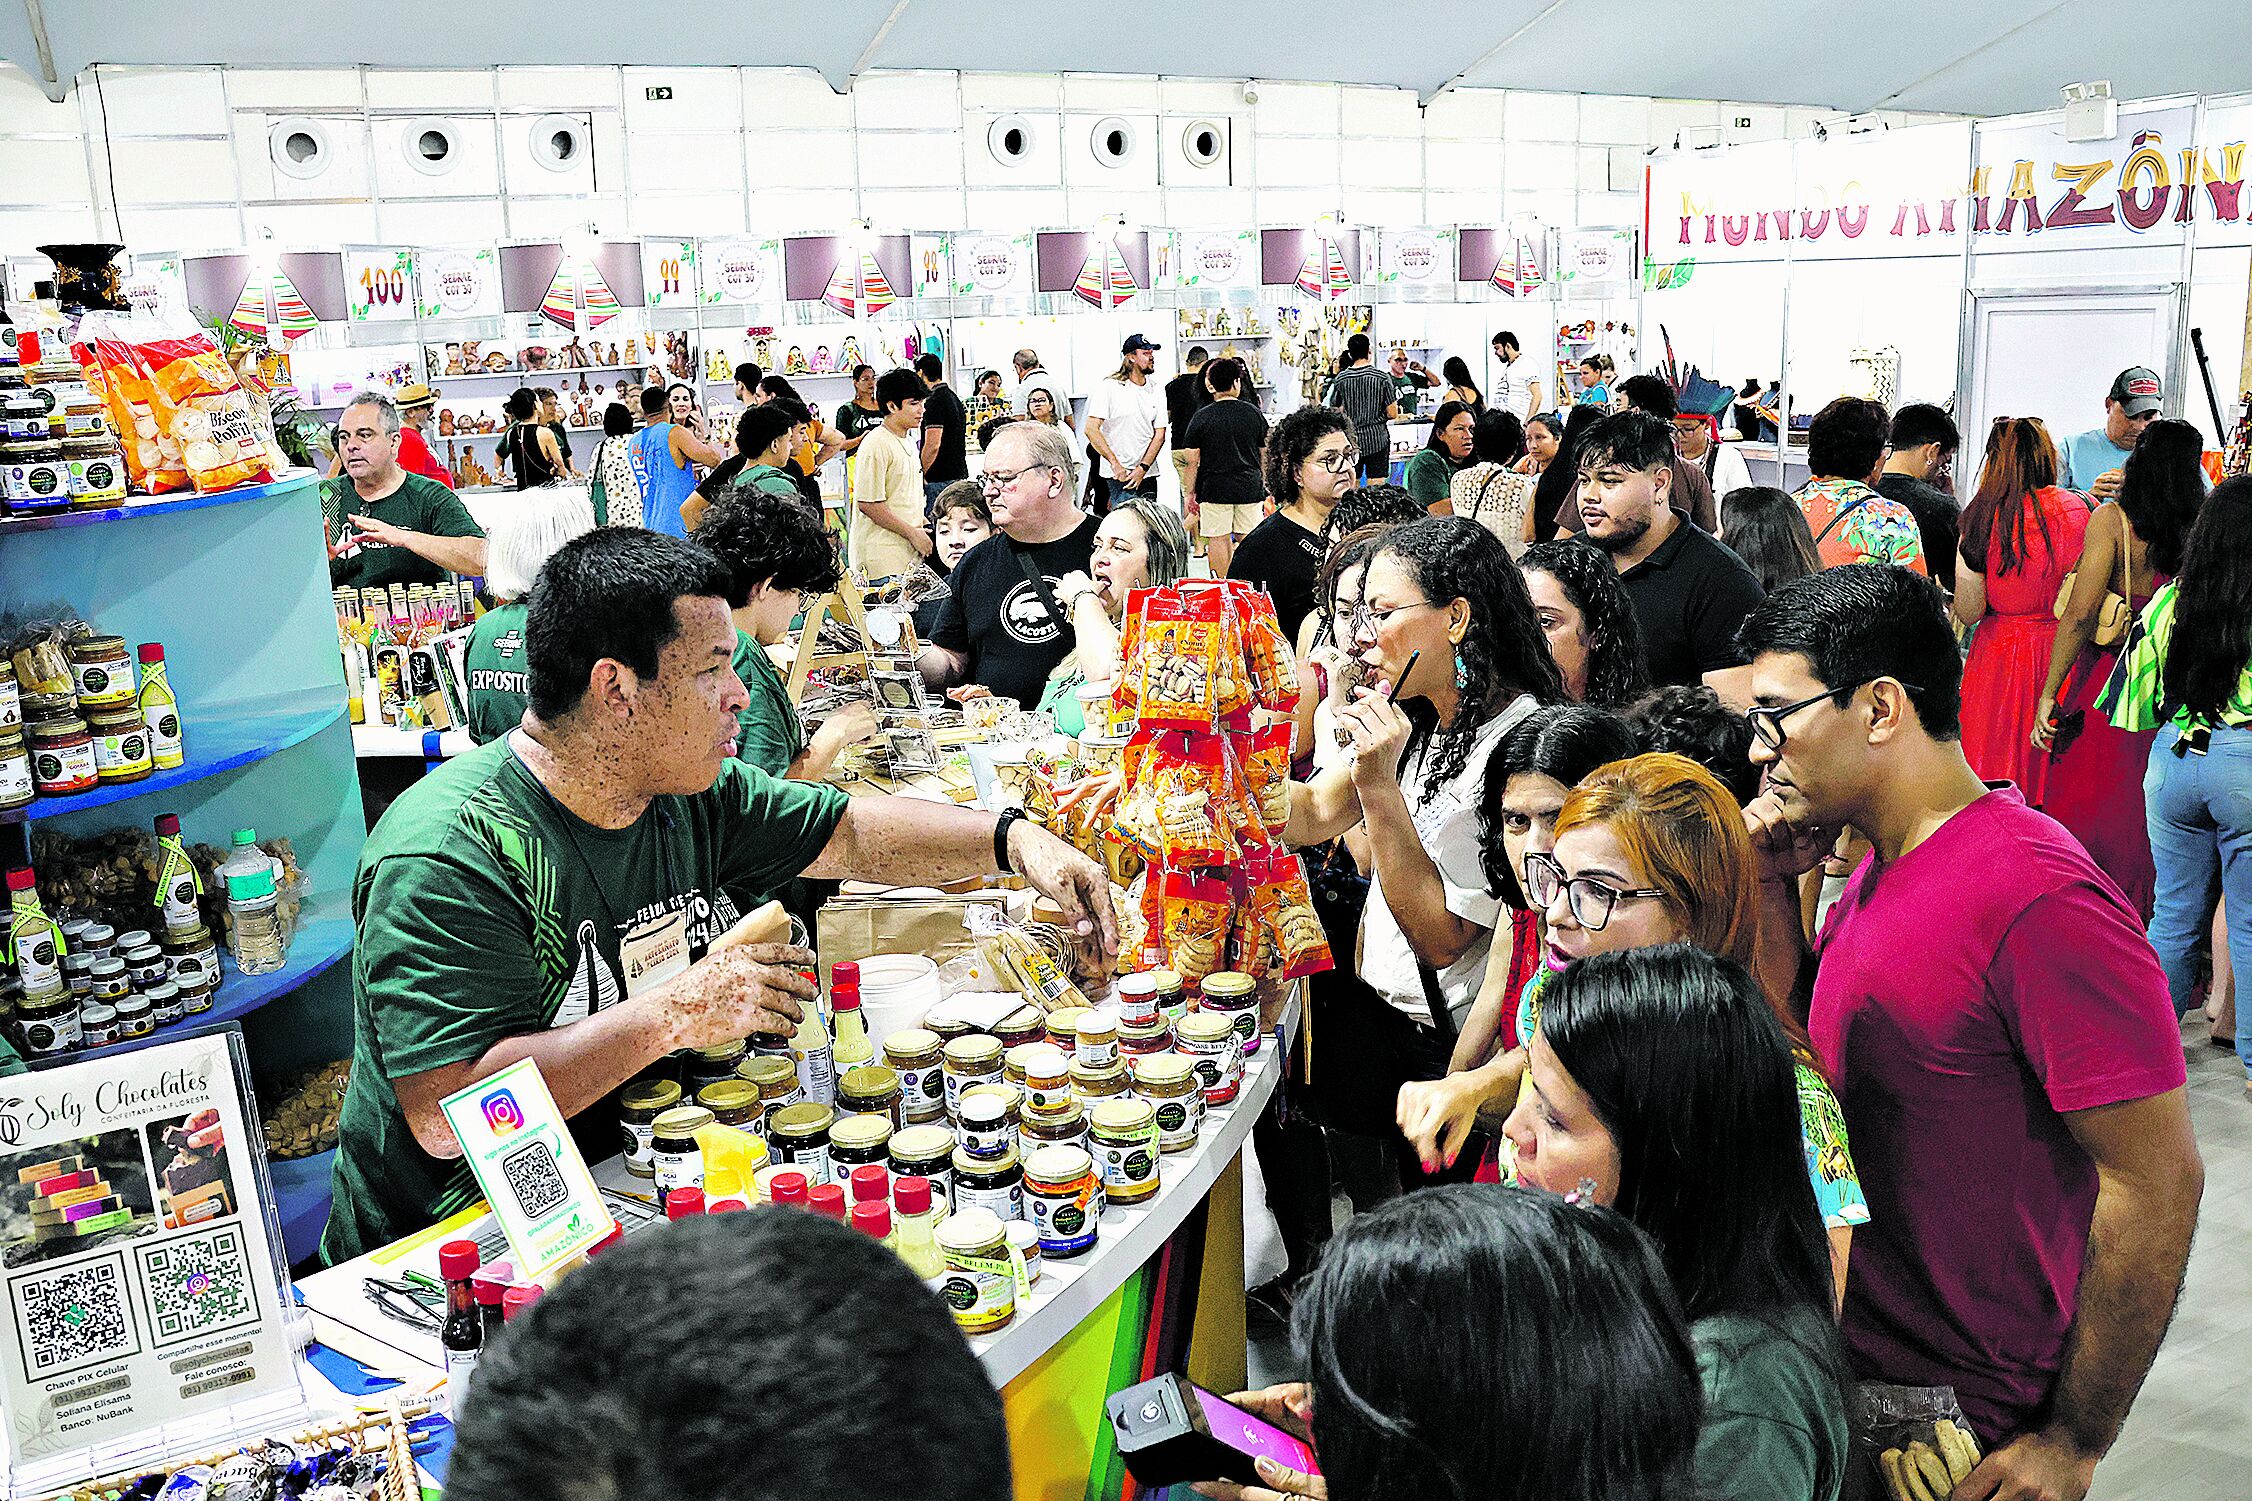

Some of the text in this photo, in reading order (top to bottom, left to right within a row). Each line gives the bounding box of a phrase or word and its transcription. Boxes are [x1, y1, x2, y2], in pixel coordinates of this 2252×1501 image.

[1678, 128, 2252, 247] MUNDO AMAZÔN
[660, 257, 680, 294] 99
[923, 249, 939, 283] 98
[359, 266, 404, 305] 100
[26, 1068, 209, 1132] Soly Chocolates
[100, 1107, 154, 1125] CONFEITARIA
[169, 1094, 211, 1109] FLORESTA
[157, 1326, 263, 1361] Compartilhe esse momento!
[45, 1363, 130, 1392] Chave PIX Celular
[184, 1359, 247, 1382] Fale conosco:
[56, 1392, 132, 1420] Soliana Elisama
[59, 1405, 135, 1433] Banco: NuBank
